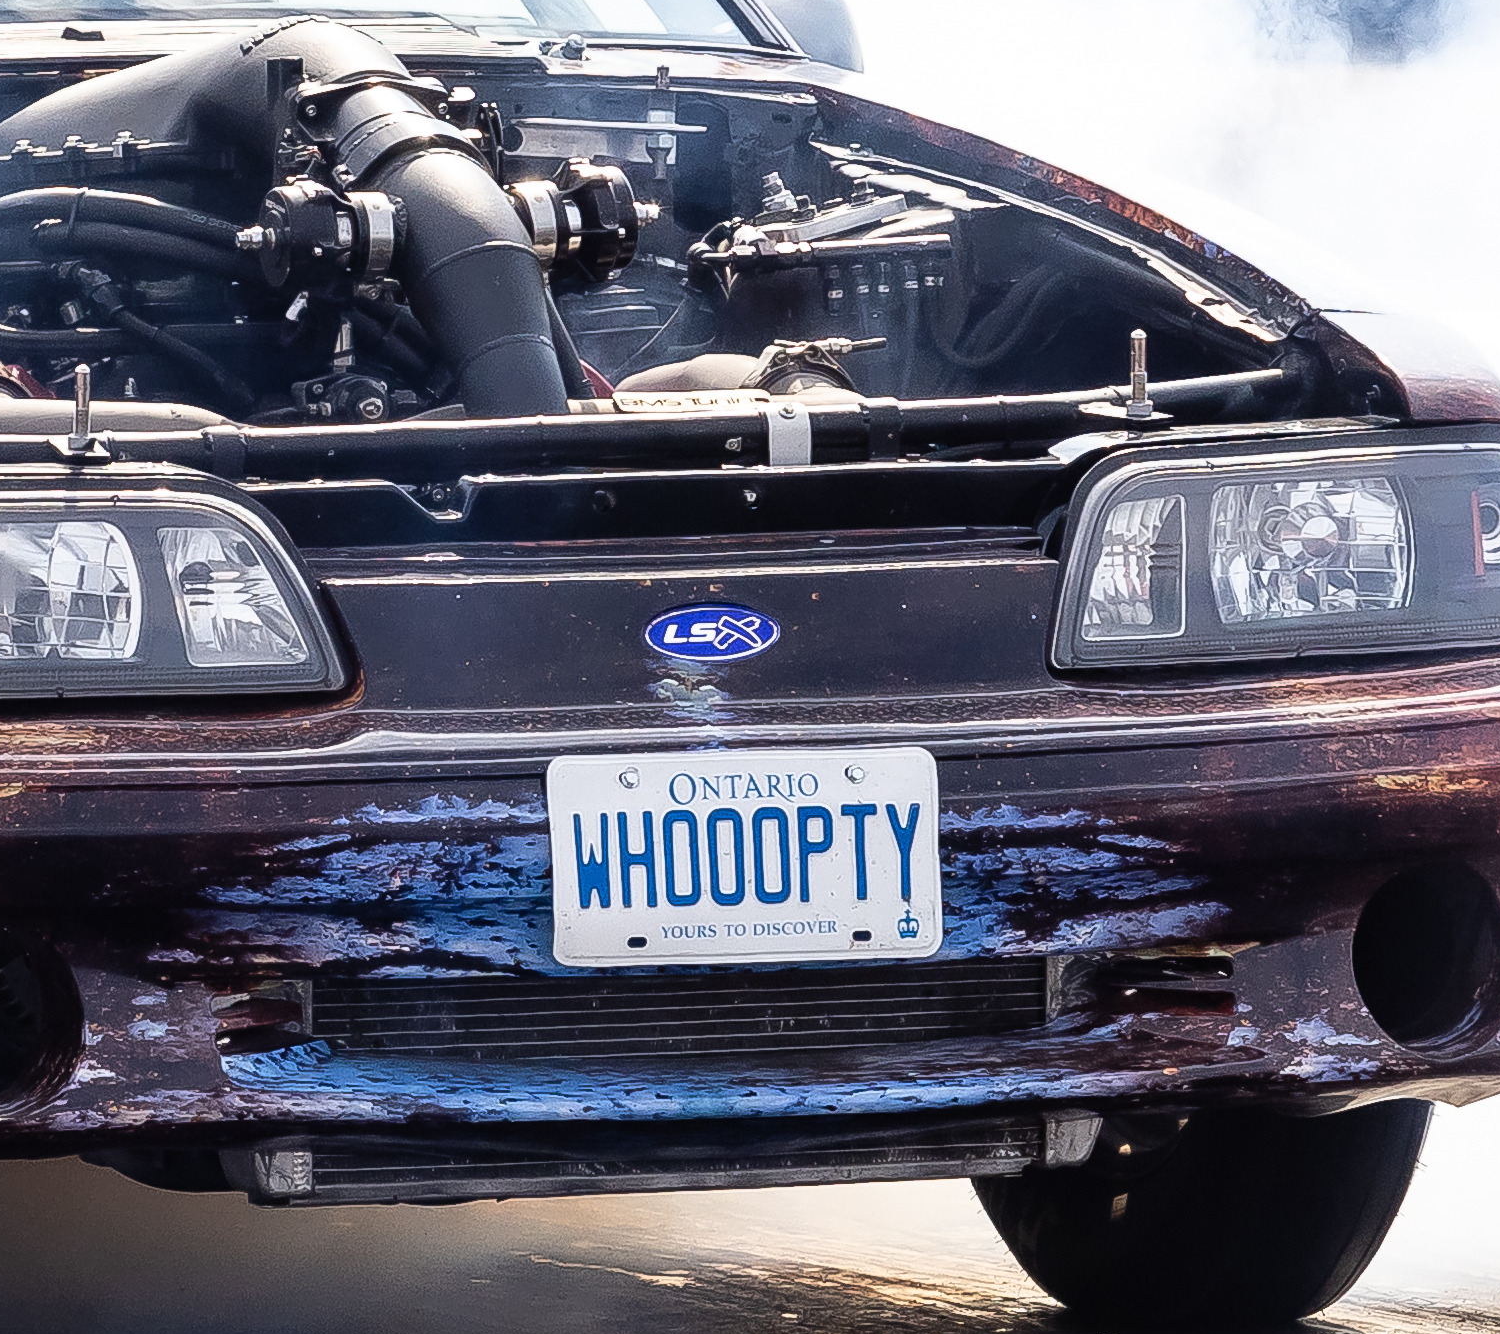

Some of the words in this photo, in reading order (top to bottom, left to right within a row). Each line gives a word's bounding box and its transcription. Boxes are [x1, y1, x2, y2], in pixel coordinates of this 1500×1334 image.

[663, 615, 763, 650] LSX
[668, 772, 820, 806] ONTARIO
[572, 802, 921, 910] WHOOOPTY
[661, 924, 718, 940] YOURS
[724, 923, 747, 937] TO
[753, 919, 839, 937] DISCOVER
